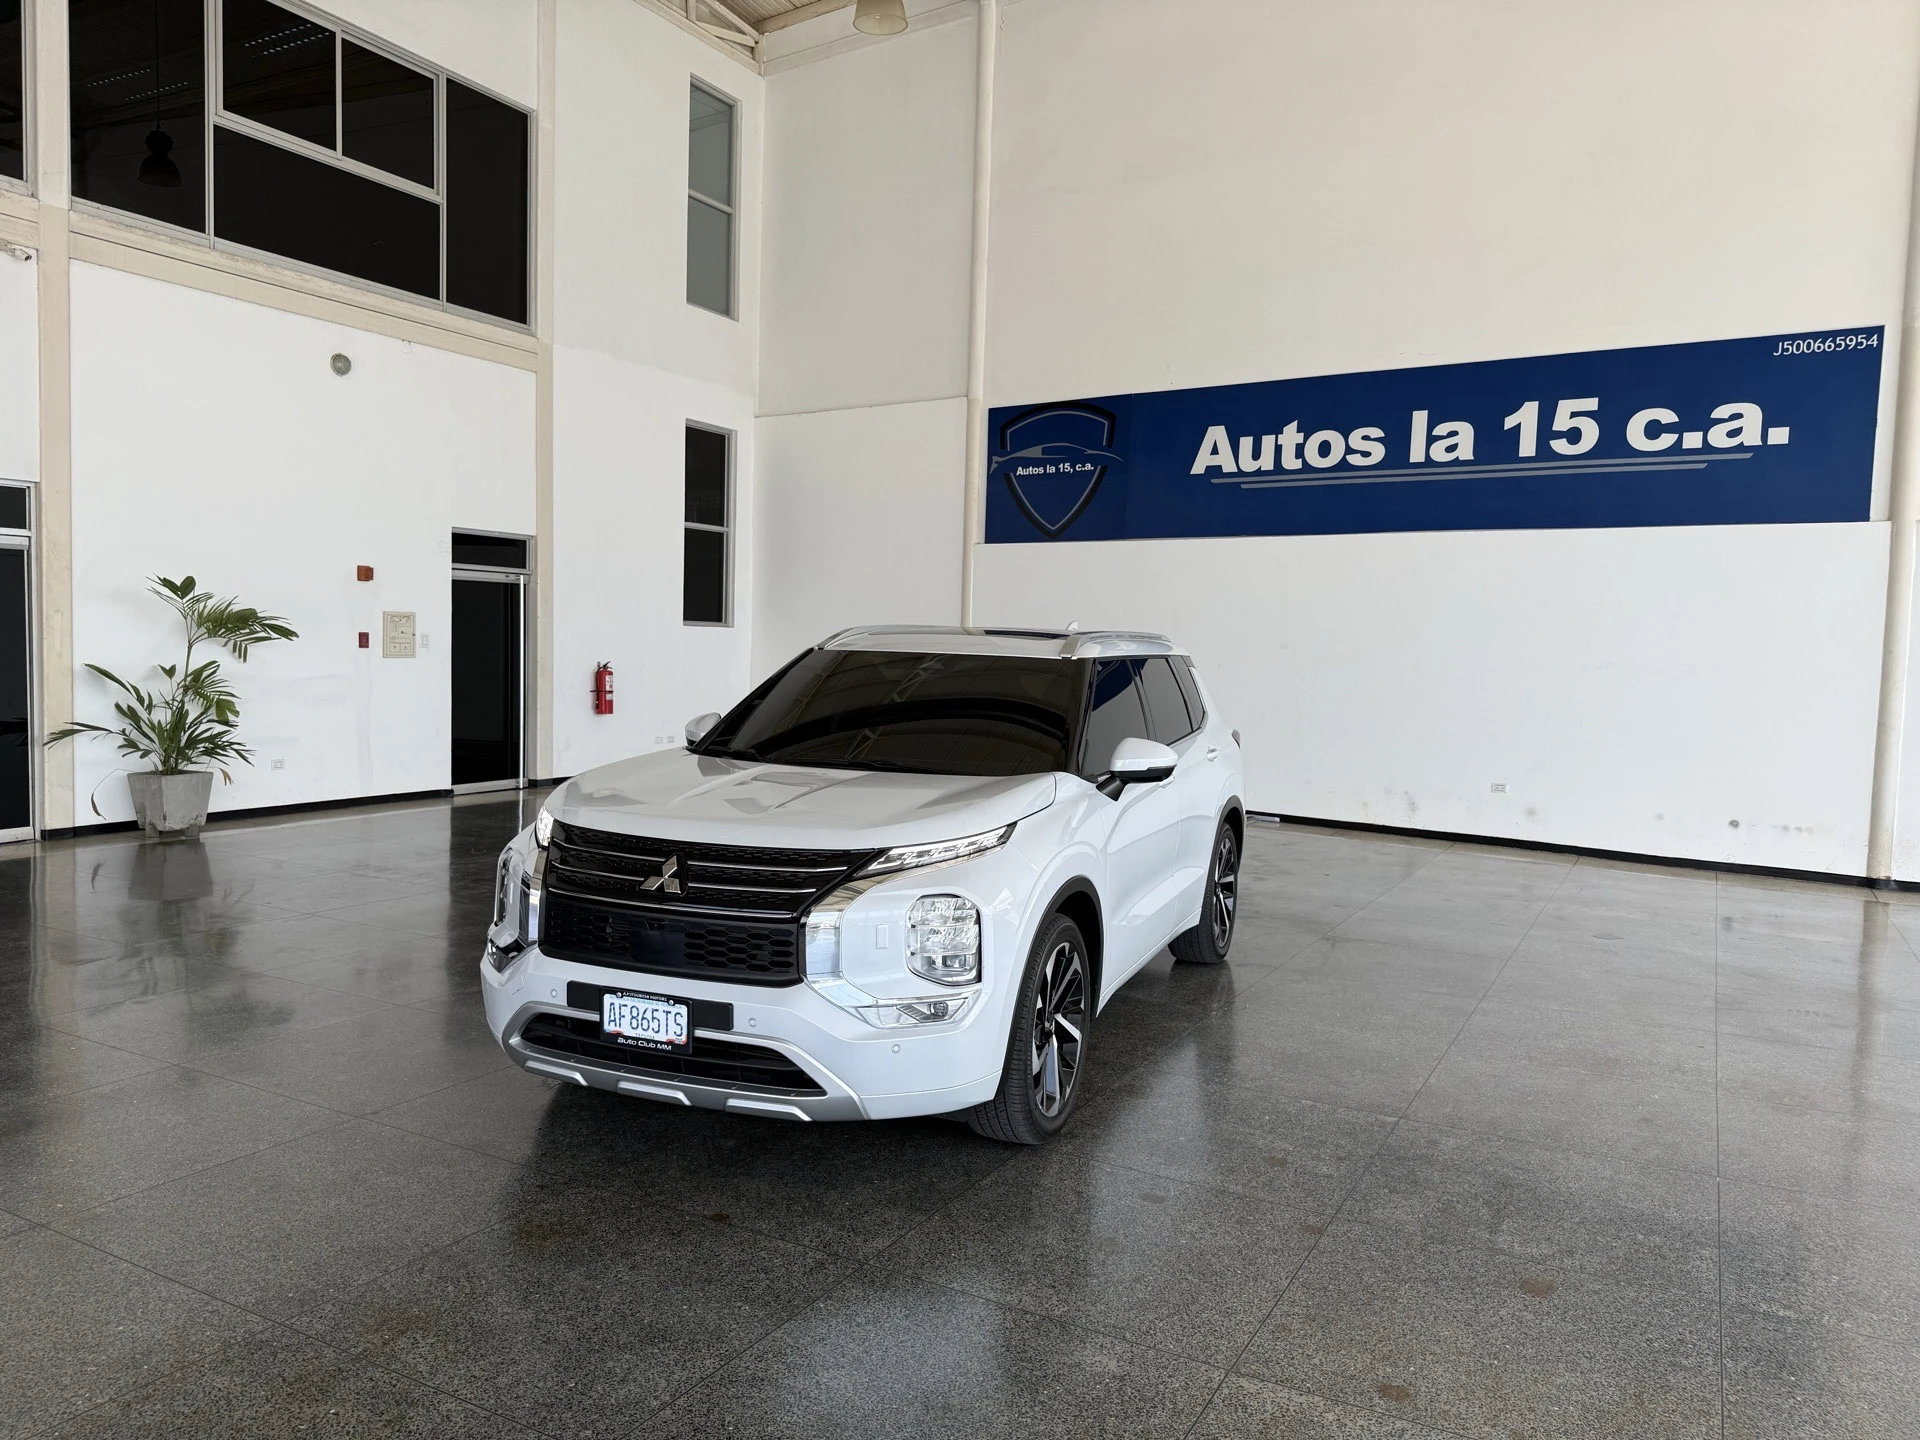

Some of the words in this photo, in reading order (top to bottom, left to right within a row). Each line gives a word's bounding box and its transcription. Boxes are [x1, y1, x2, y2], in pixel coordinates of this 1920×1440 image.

[1773, 333, 1879, 356] J500665954
[1190, 420, 1386, 475] Autos
[1409, 409, 1475, 463] la
[1503, 397, 1600, 458] 15
[1626, 402, 1791, 452] c.a.
[1016, 466, 1044, 476] Autos
[1046, 464, 1056, 474] la
[1058, 463, 1073, 474] 15,
[1075, 462, 1094, 472] c.a.
[608, 1002, 684, 1037] AF865TS
[638, 1040, 656, 1049] Club
[657, 1043, 672, 1051] MM
